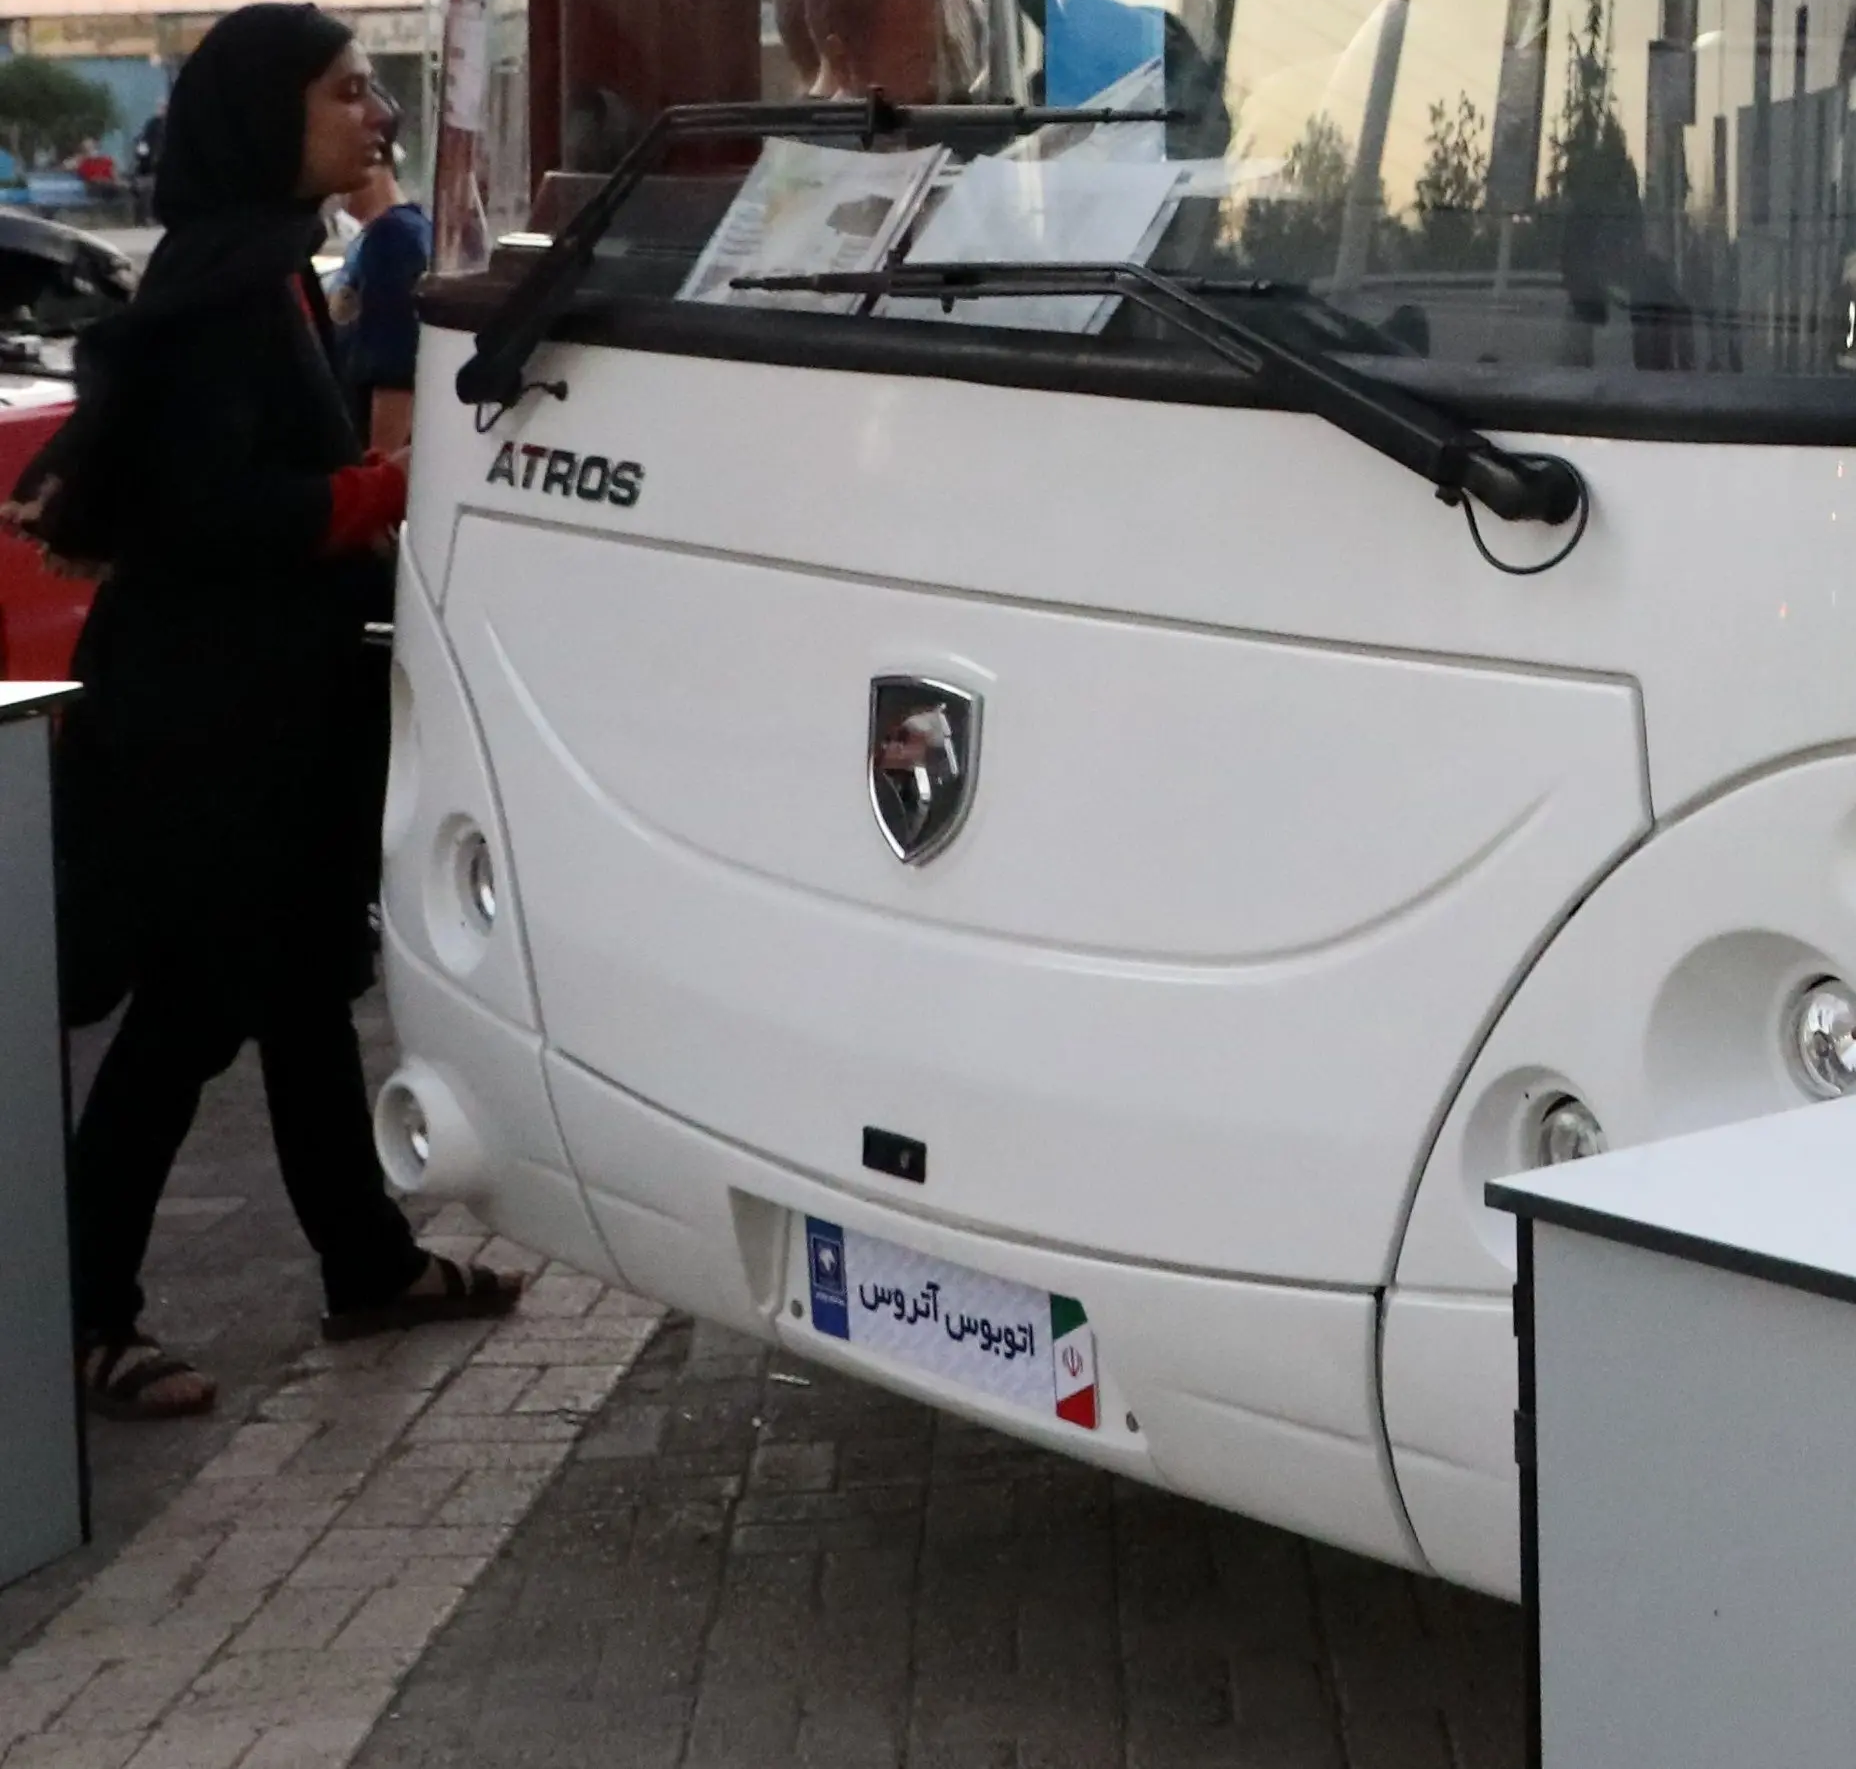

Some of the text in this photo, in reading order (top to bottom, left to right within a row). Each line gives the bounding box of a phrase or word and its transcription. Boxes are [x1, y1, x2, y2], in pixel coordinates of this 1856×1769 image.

[486, 440, 645, 507] ATROS
[859, 1280, 1035, 1360] اتوبوس آتروس
